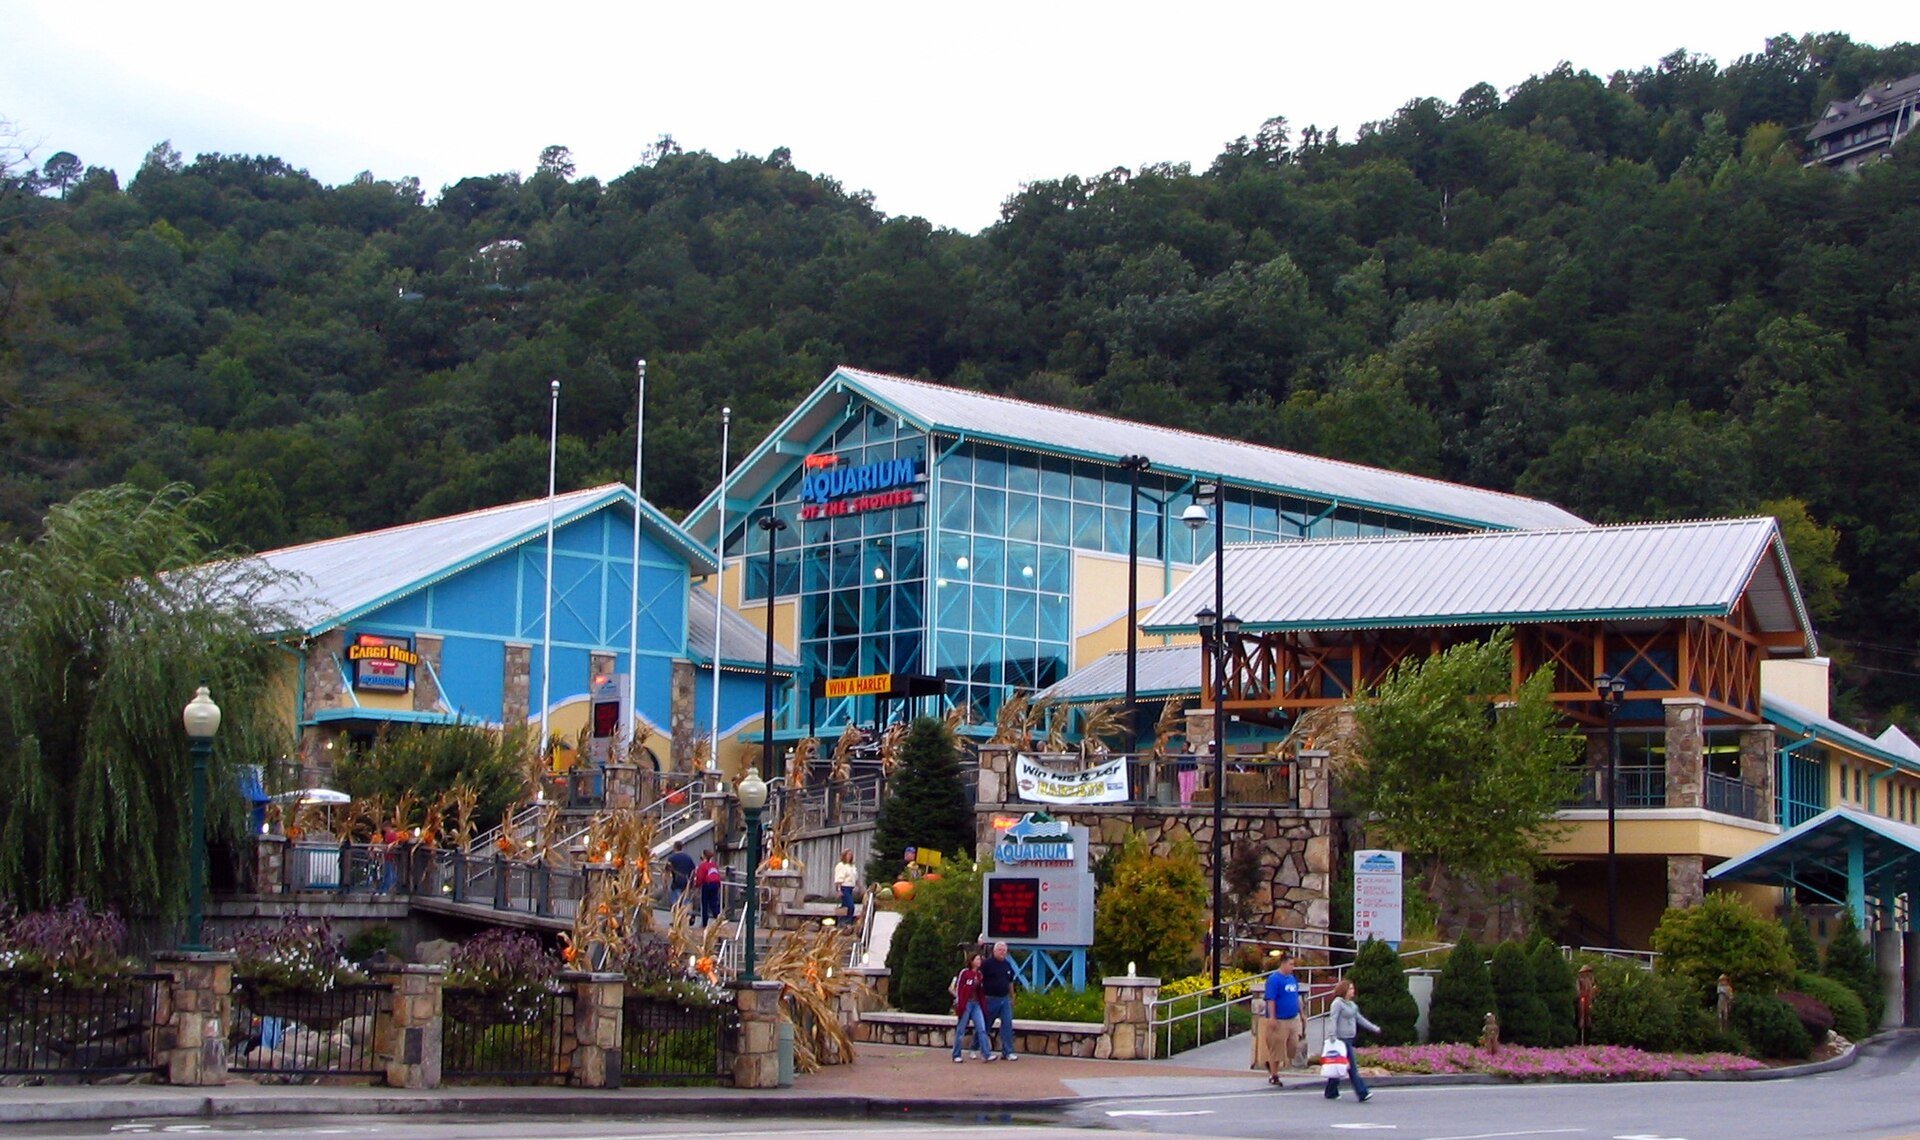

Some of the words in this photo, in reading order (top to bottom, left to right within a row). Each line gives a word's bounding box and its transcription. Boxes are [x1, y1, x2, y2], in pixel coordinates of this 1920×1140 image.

[801, 457, 915, 503] AQUARIUM
[802, 506, 819, 519] OF
[824, 500, 848, 517] THE
[853, 490, 913, 512] SMOKIES
[349, 645, 388, 660] CARGO
[389, 645, 418, 665] HOLD
[829, 681, 847, 695] WIN
[848, 680, 855, 693] A
[857, 677, 888, 692] HARLEY
[1023, 764, 1047, 778] Win
[1079, 772, 1090, 782] &
[995, 843, 1068, 866] AQUARIUM
